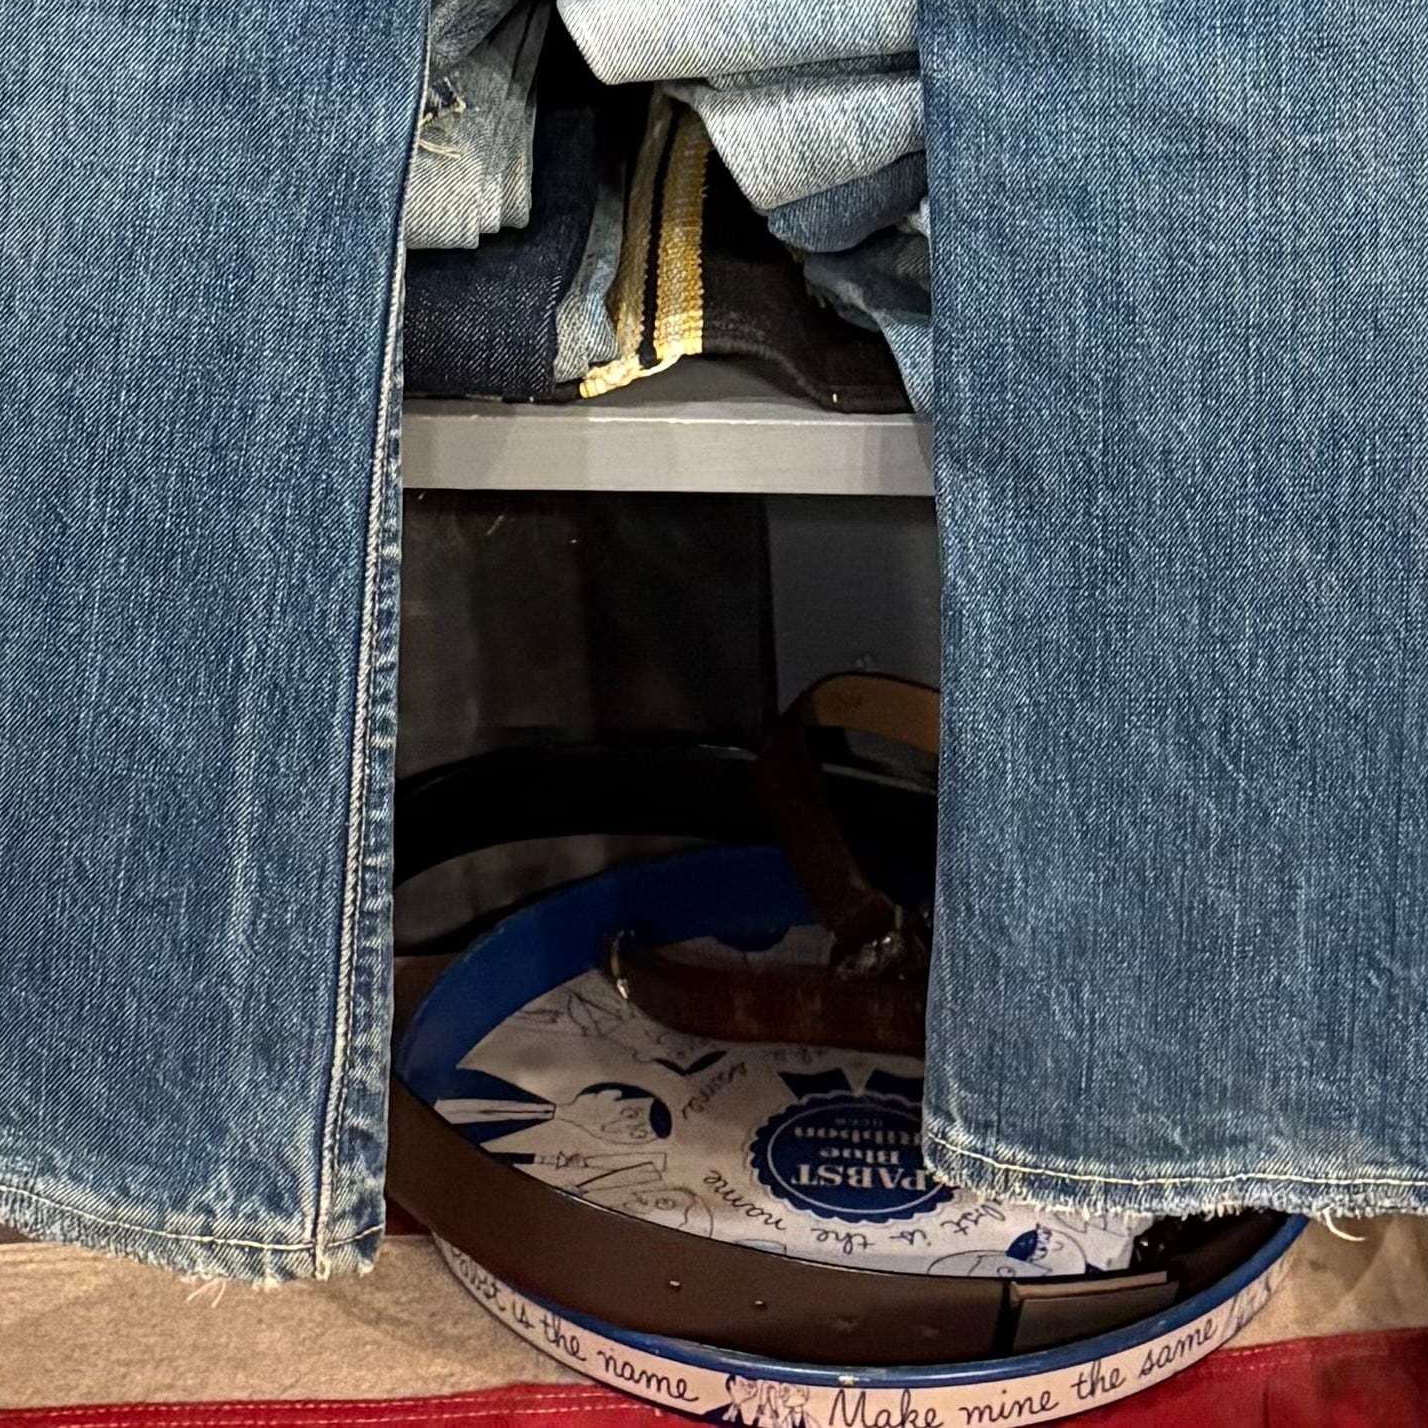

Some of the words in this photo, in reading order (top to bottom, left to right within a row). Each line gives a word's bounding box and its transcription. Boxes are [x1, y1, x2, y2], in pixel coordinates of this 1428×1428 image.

[819, 1147, 900, 1164] Blue
[791, 1164, 926, 1191] PABST
[703, 1169, 786, 1231] name
[812, 1227, 876, 1255] the
[889, 1227, 932, 1246] is
[540, 1312, 588, 1362] the
[596, 1348, 699, 1402] name
[828, 1388, 945, 1428] Make
[959, 1390, 1059, 1425] mine
[1070, 1360, 1127, 1400] the
[1138, 1317, 1219, 1378] same
